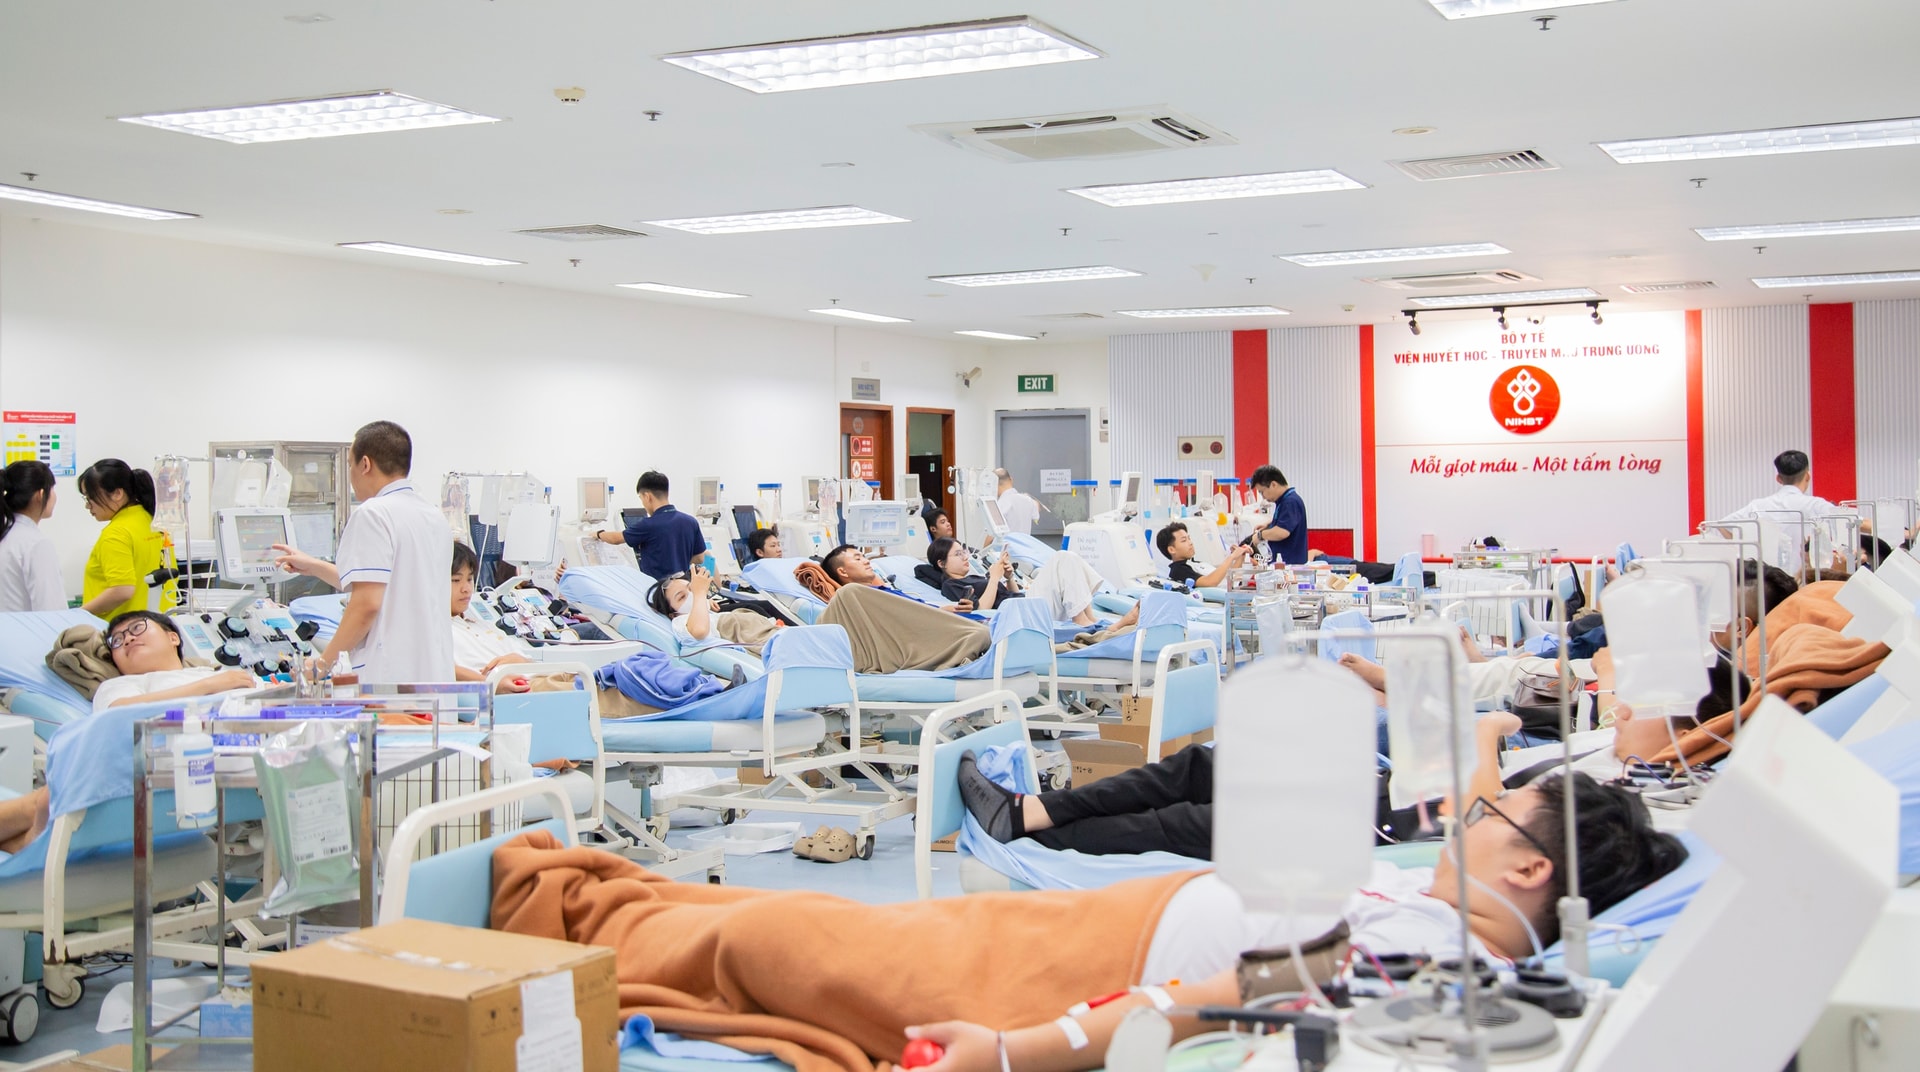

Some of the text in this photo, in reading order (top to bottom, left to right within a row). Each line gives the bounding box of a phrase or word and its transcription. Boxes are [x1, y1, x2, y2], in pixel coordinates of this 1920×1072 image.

[1520, 333, 1527, 343] Y
[1394, 350, 1420, 366] VIỆN
[1423, 347, 1460, 363] HUYẾT
[1583, 345, 1622, 357] TRUNG
[1024, 377, 1048, 390] EXIT
[1505, 417, 1543, 426] NIHBT
[1410, 455, 1441, 474] Mỗi
[1443, 458, 1477, 478] giọt
[1479, 457, 1518, 473] máu
[1532, 456, 1568, 475] Một
[1573, 452, 1611, 471] tấm
[1618, 453, 1662, 474] lòng
